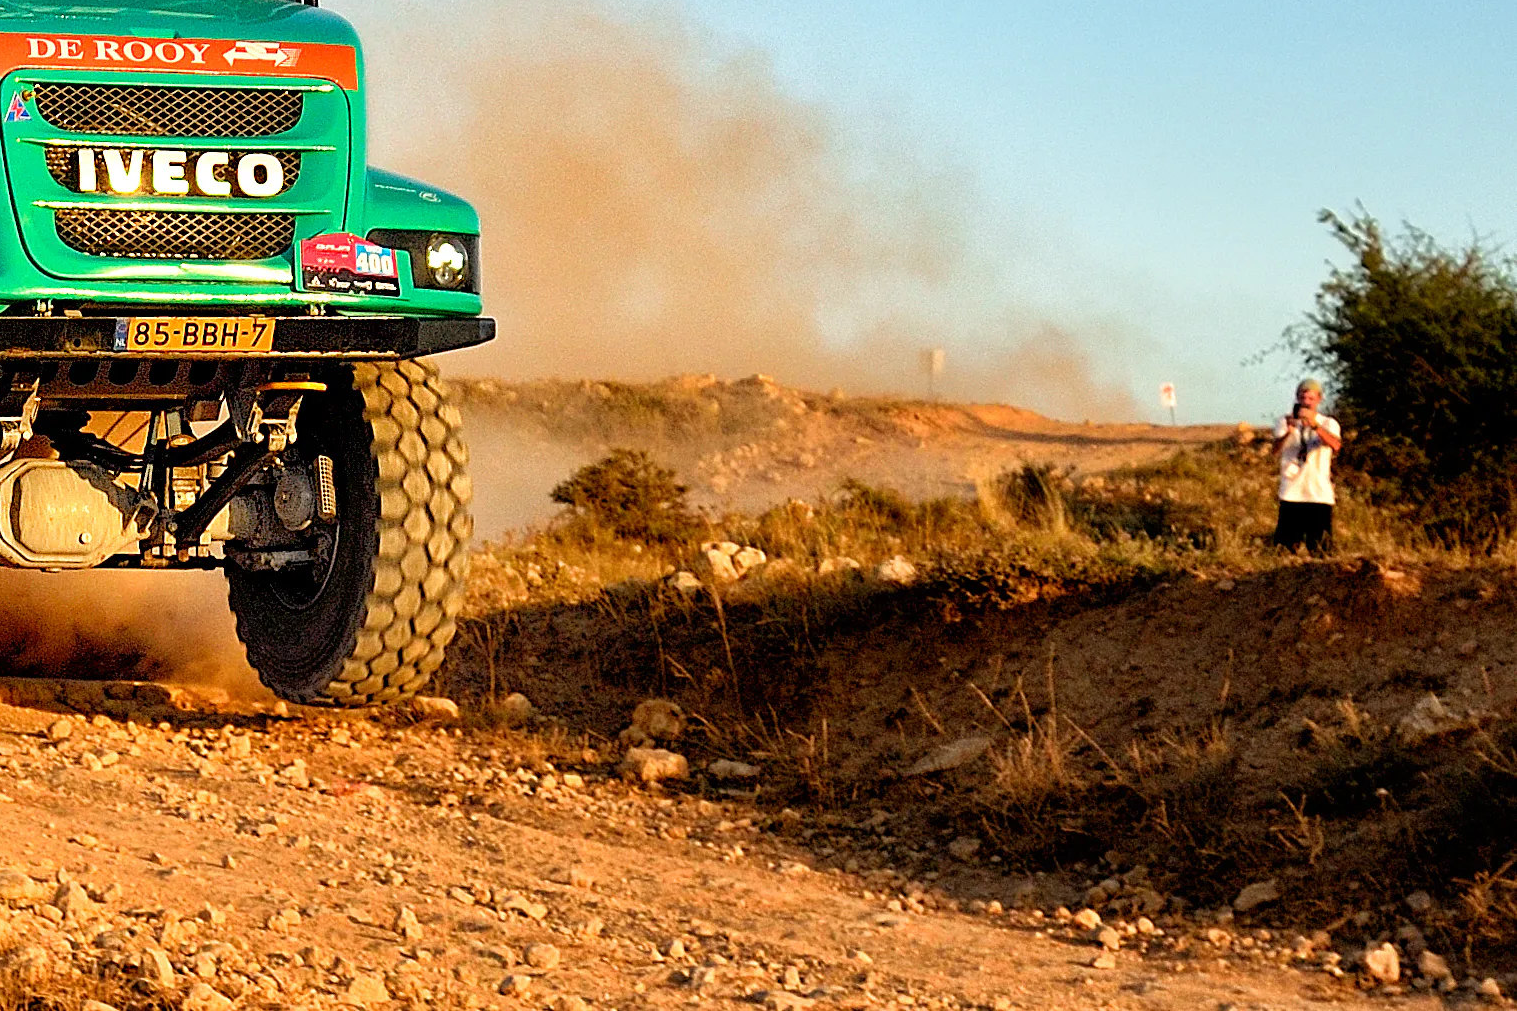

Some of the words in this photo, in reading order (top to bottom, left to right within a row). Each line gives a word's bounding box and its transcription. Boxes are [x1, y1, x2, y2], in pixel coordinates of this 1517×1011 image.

[26, 37, 85, 61] DE
[94, 39, 211, 65] ROOY
[78, 149, 284, 197] IVECO
[355, 252, 395, 275] 400
[115, 339, 127, 347] NL
[133, 322, 268, 347] 85-BBH-7
